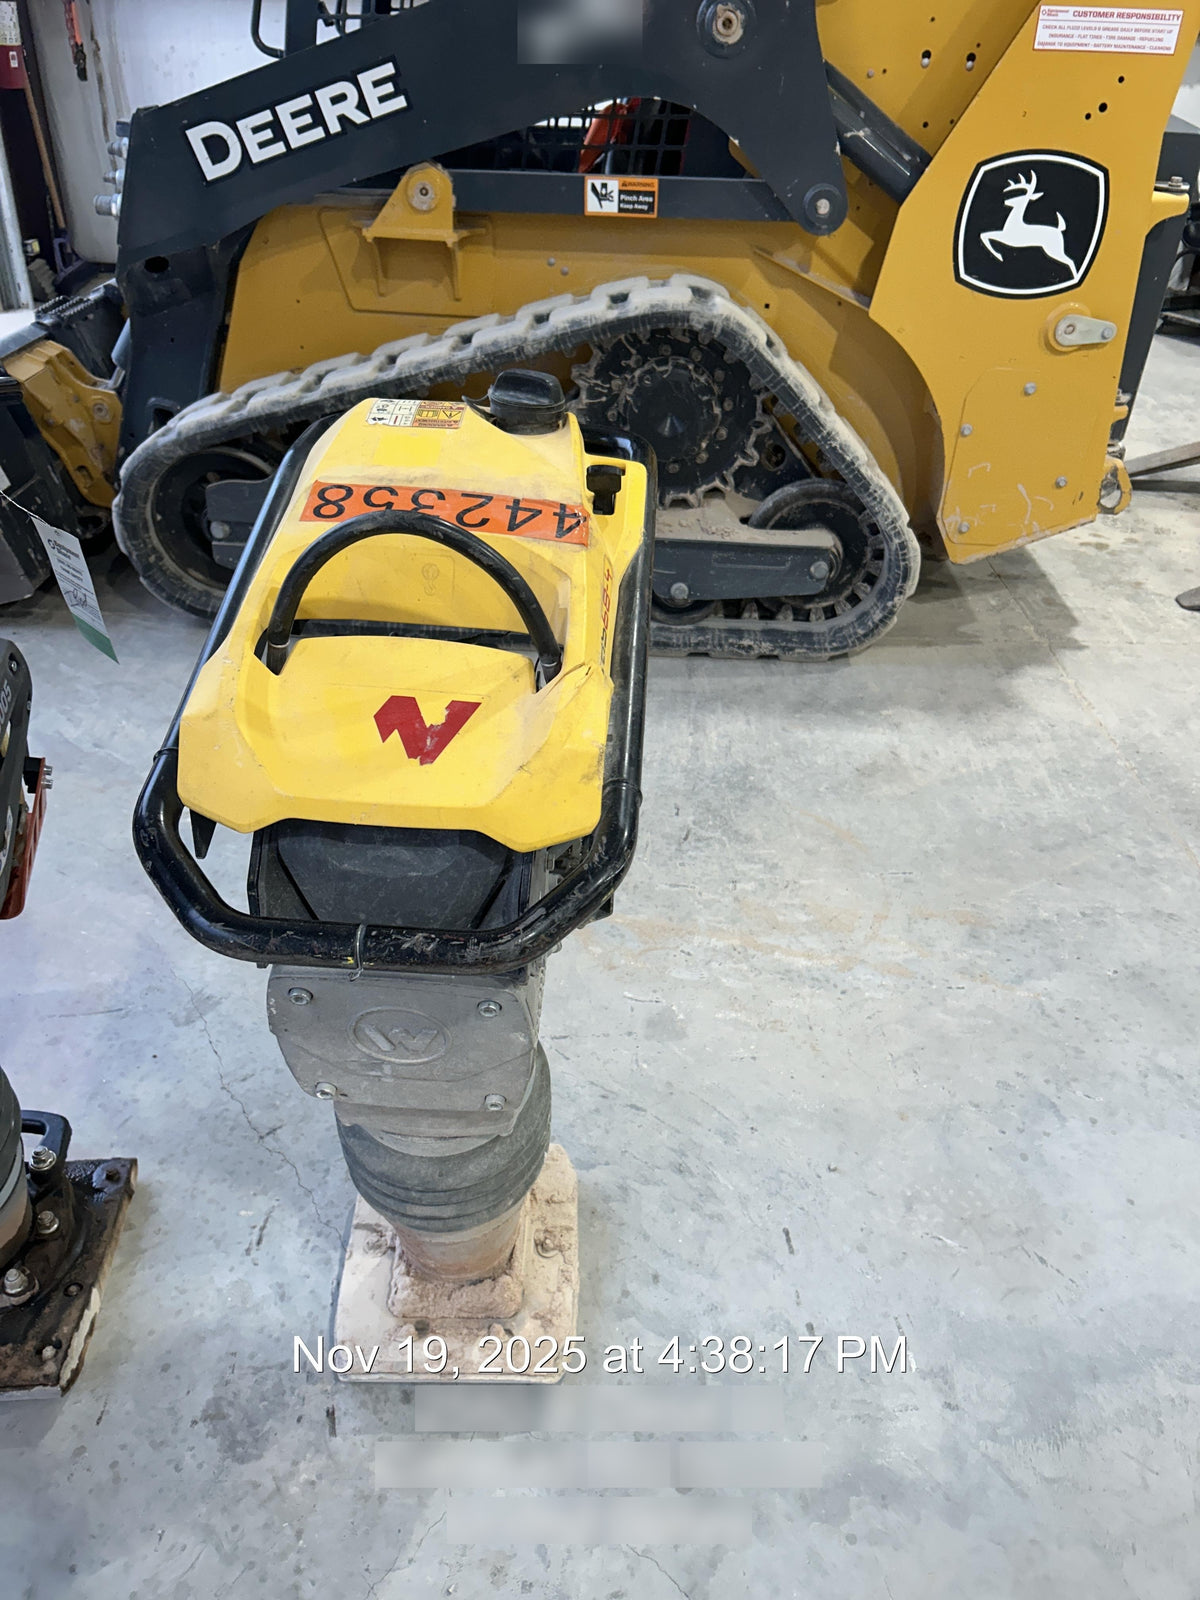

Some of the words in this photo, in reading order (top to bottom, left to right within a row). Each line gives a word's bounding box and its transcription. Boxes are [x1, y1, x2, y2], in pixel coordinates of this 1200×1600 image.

[1072, 9, 1115, 18] CUSTOMER
[1115, 11, 1181, 21] RESPONSIBILITY
[185, 62, 408, 181] DEERE
[620, 194, 638, 202] Pinch
[634, 203, 649, 211] Away
[312, 484, 587, 539] 442358
